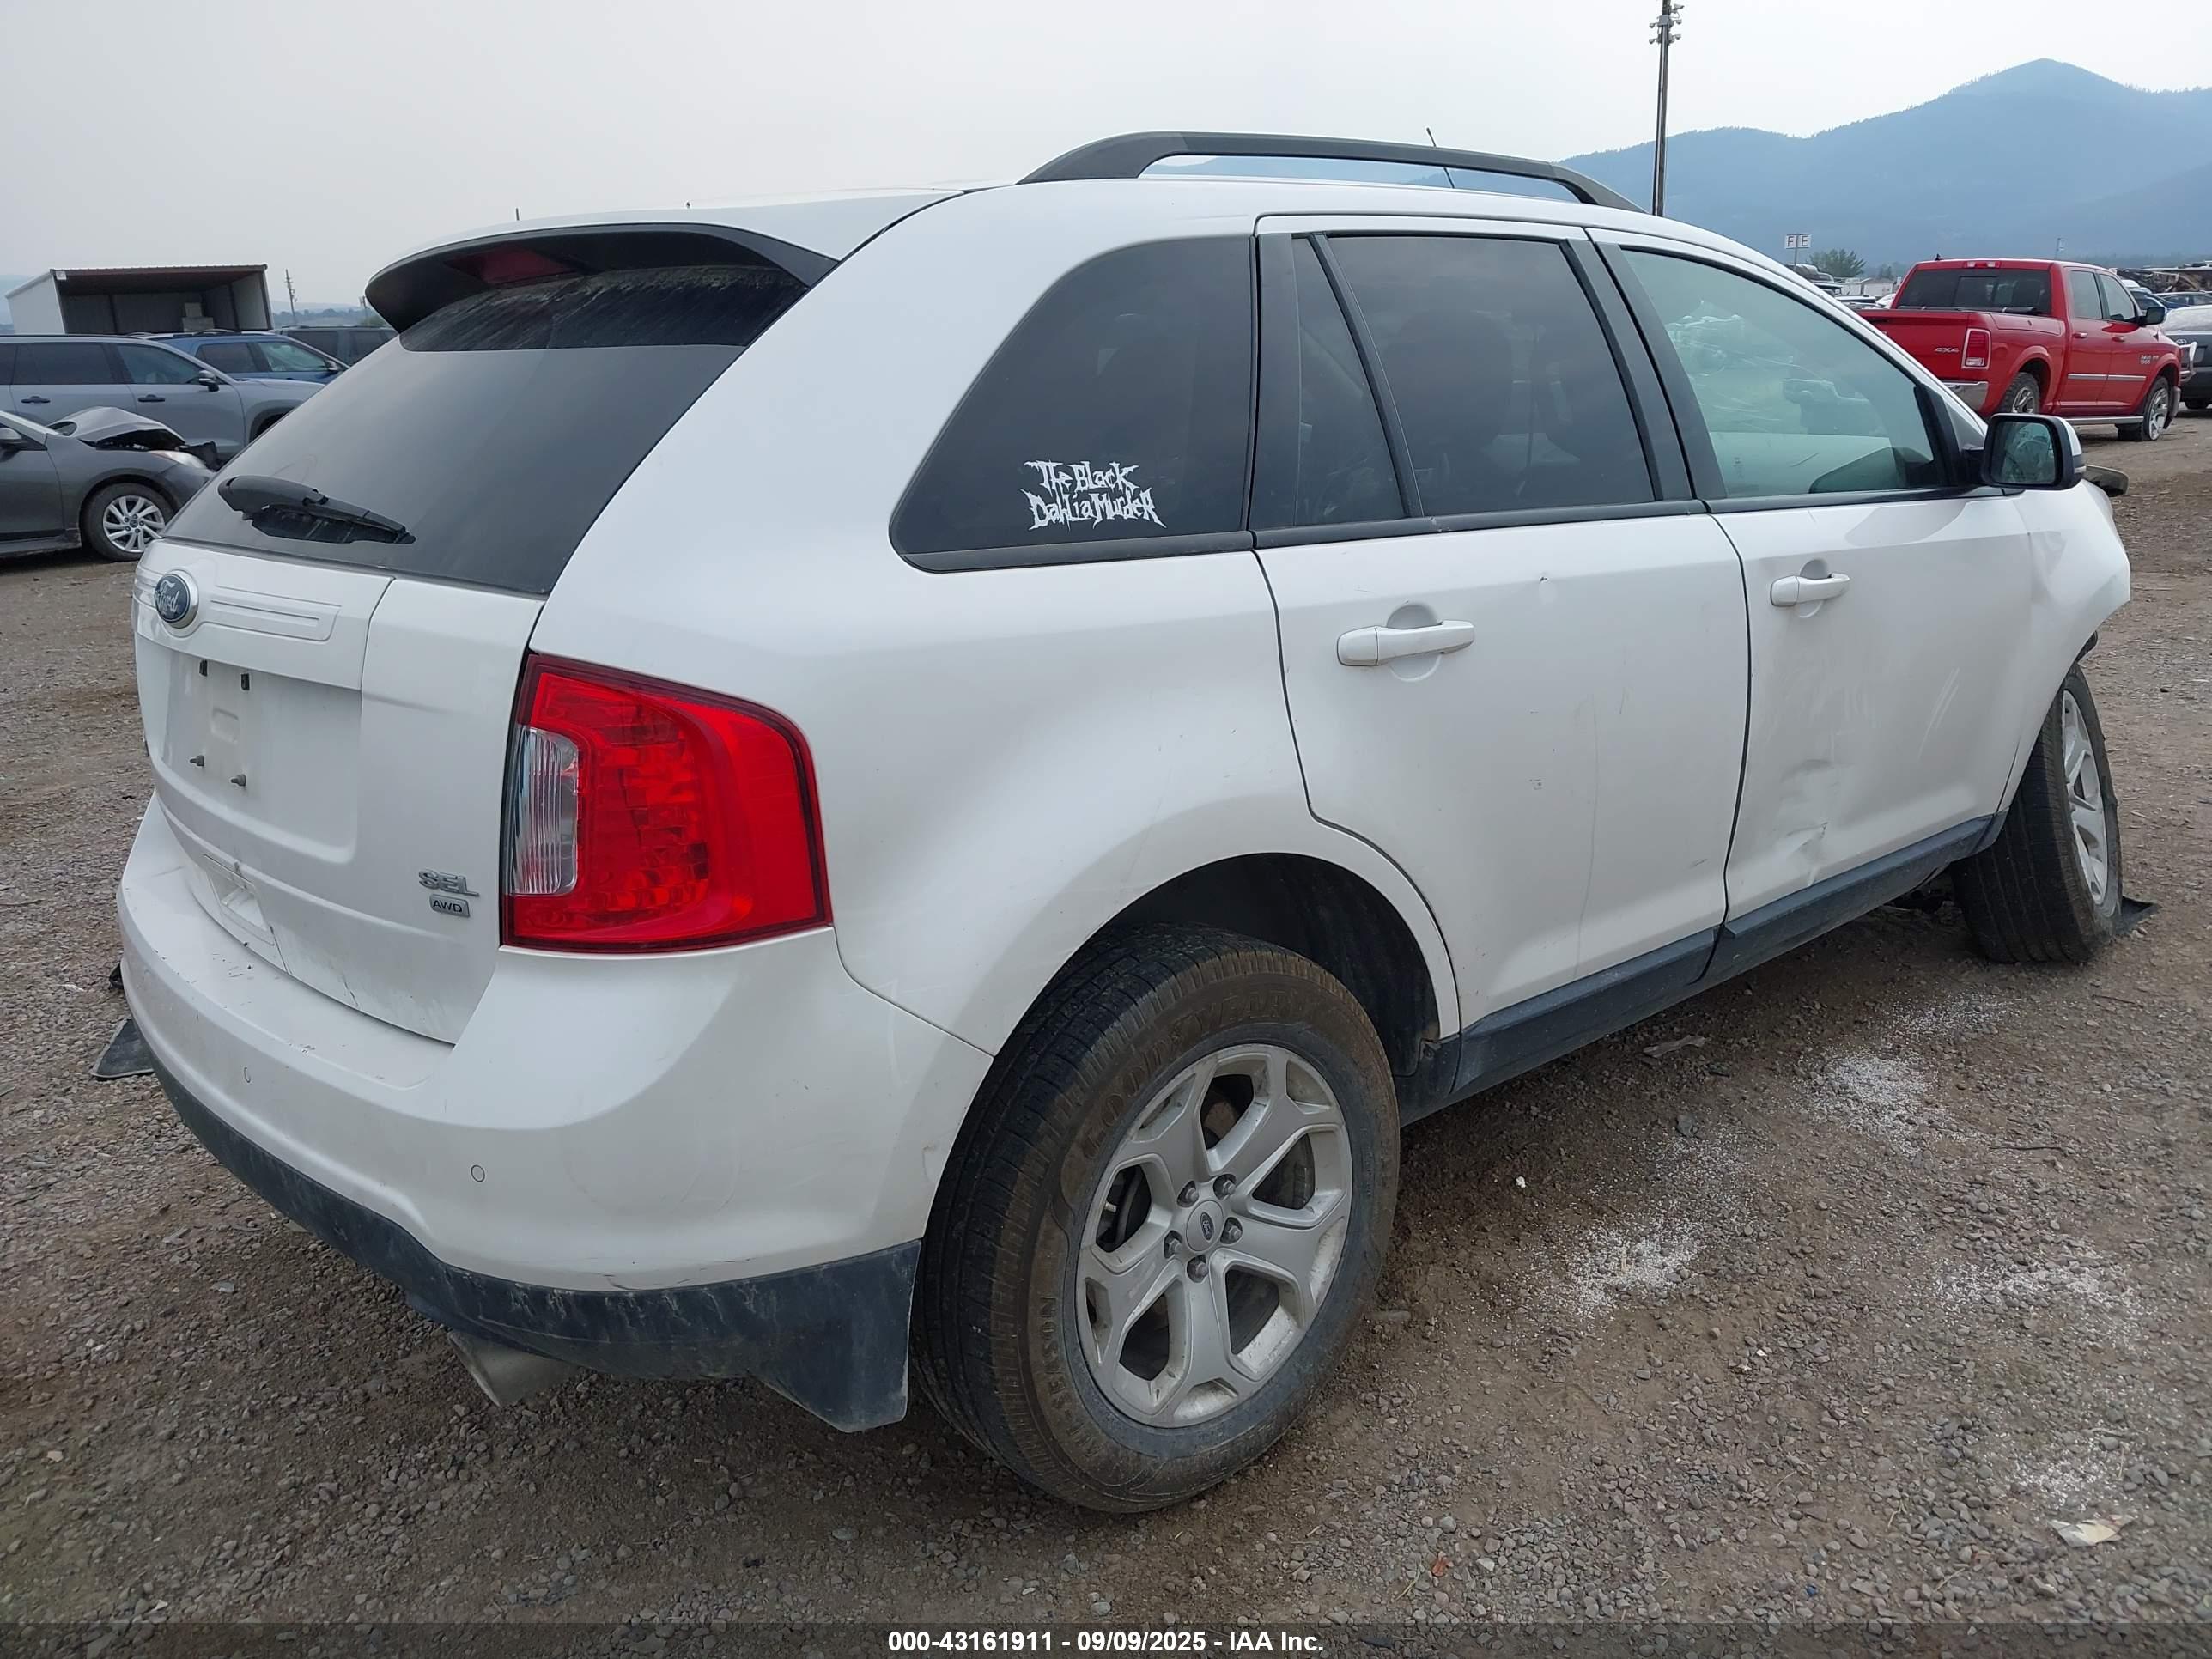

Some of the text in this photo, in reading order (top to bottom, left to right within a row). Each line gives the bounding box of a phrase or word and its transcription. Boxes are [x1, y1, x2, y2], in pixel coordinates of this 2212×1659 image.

[1787, 235, 1808, 247] F E
[418, 868, 480, 897] SEL
[433, 899, 463, 913] AWD
